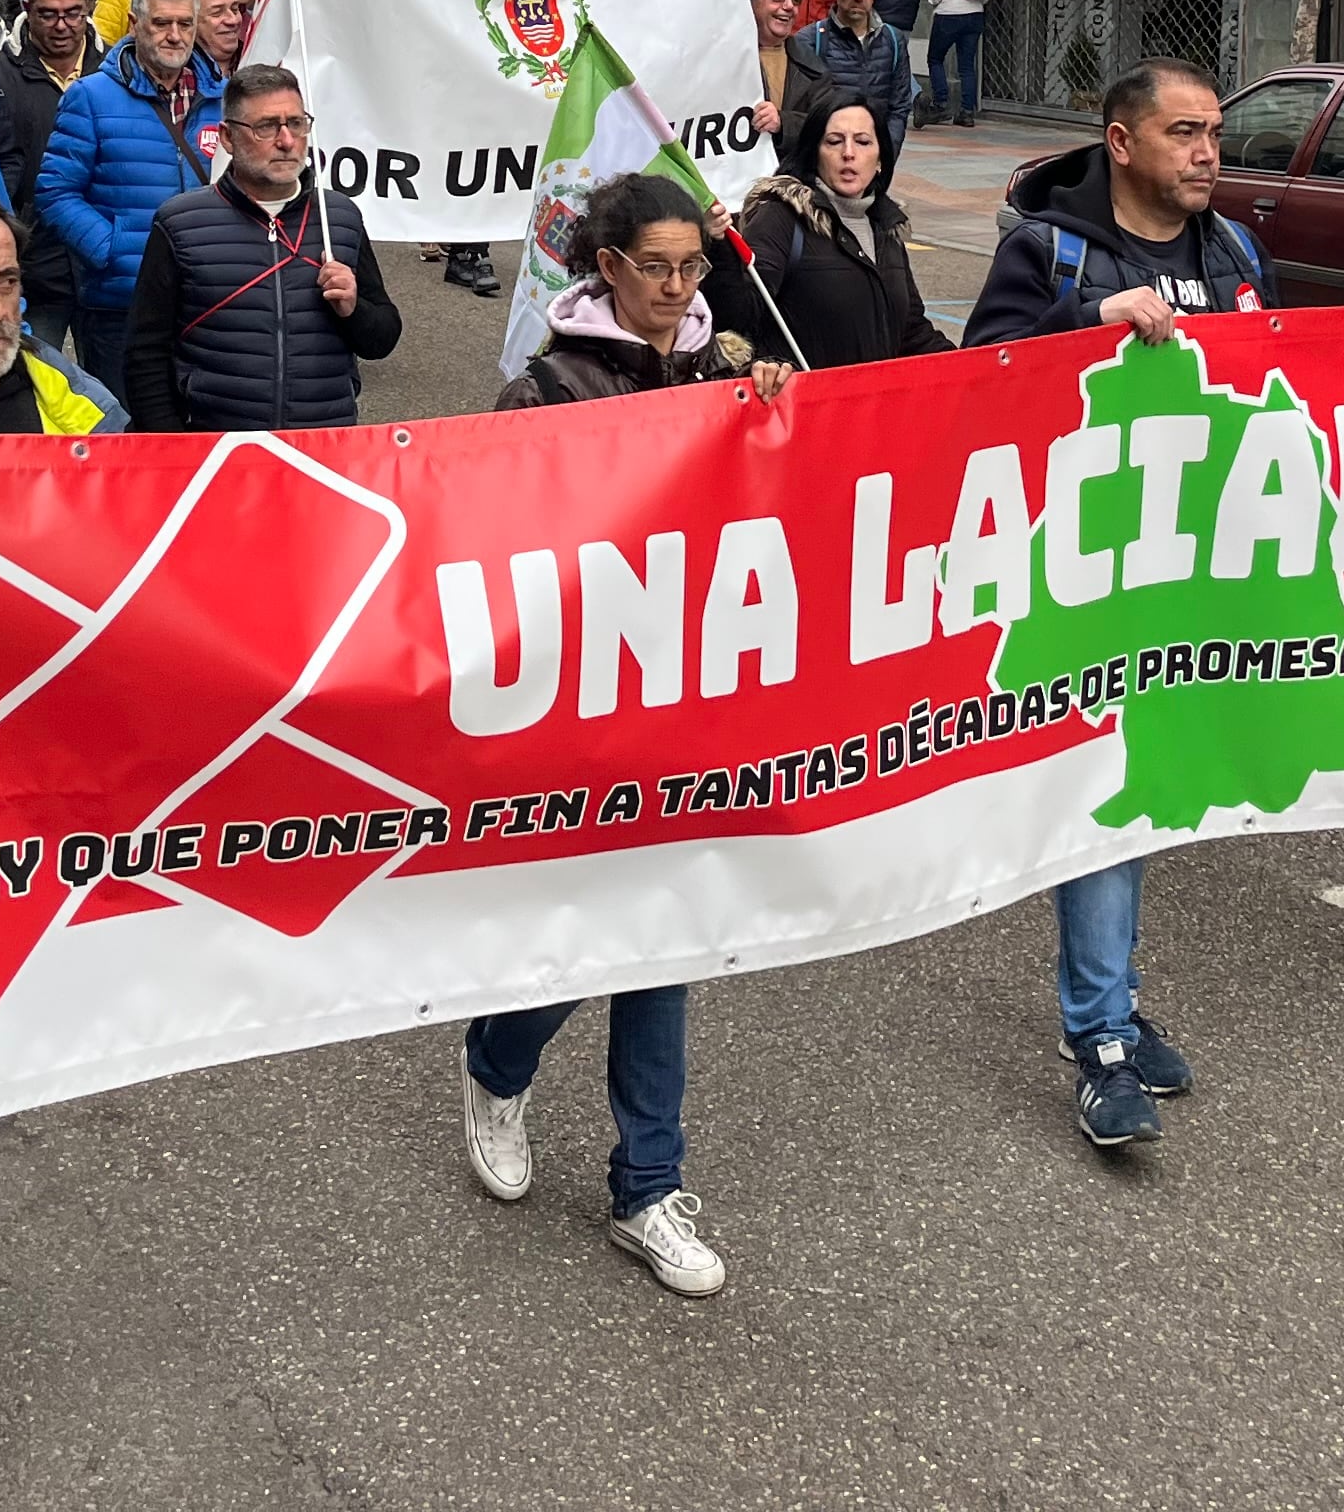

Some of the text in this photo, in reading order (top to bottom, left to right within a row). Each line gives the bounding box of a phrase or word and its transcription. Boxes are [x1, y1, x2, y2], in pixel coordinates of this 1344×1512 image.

[436, 516, 800, 738] UNA
[57, 823, 207, 889] QUE
[217, 804, 451, 868] PONER
[463, 787, 590, 844] FIN
[597, 781, 643, 826] A
[659, 733, 868, 817] TANTAS
[877, 674, 1070, 777] DÉCADAS
[1078, 655, 1128, 711] DE
